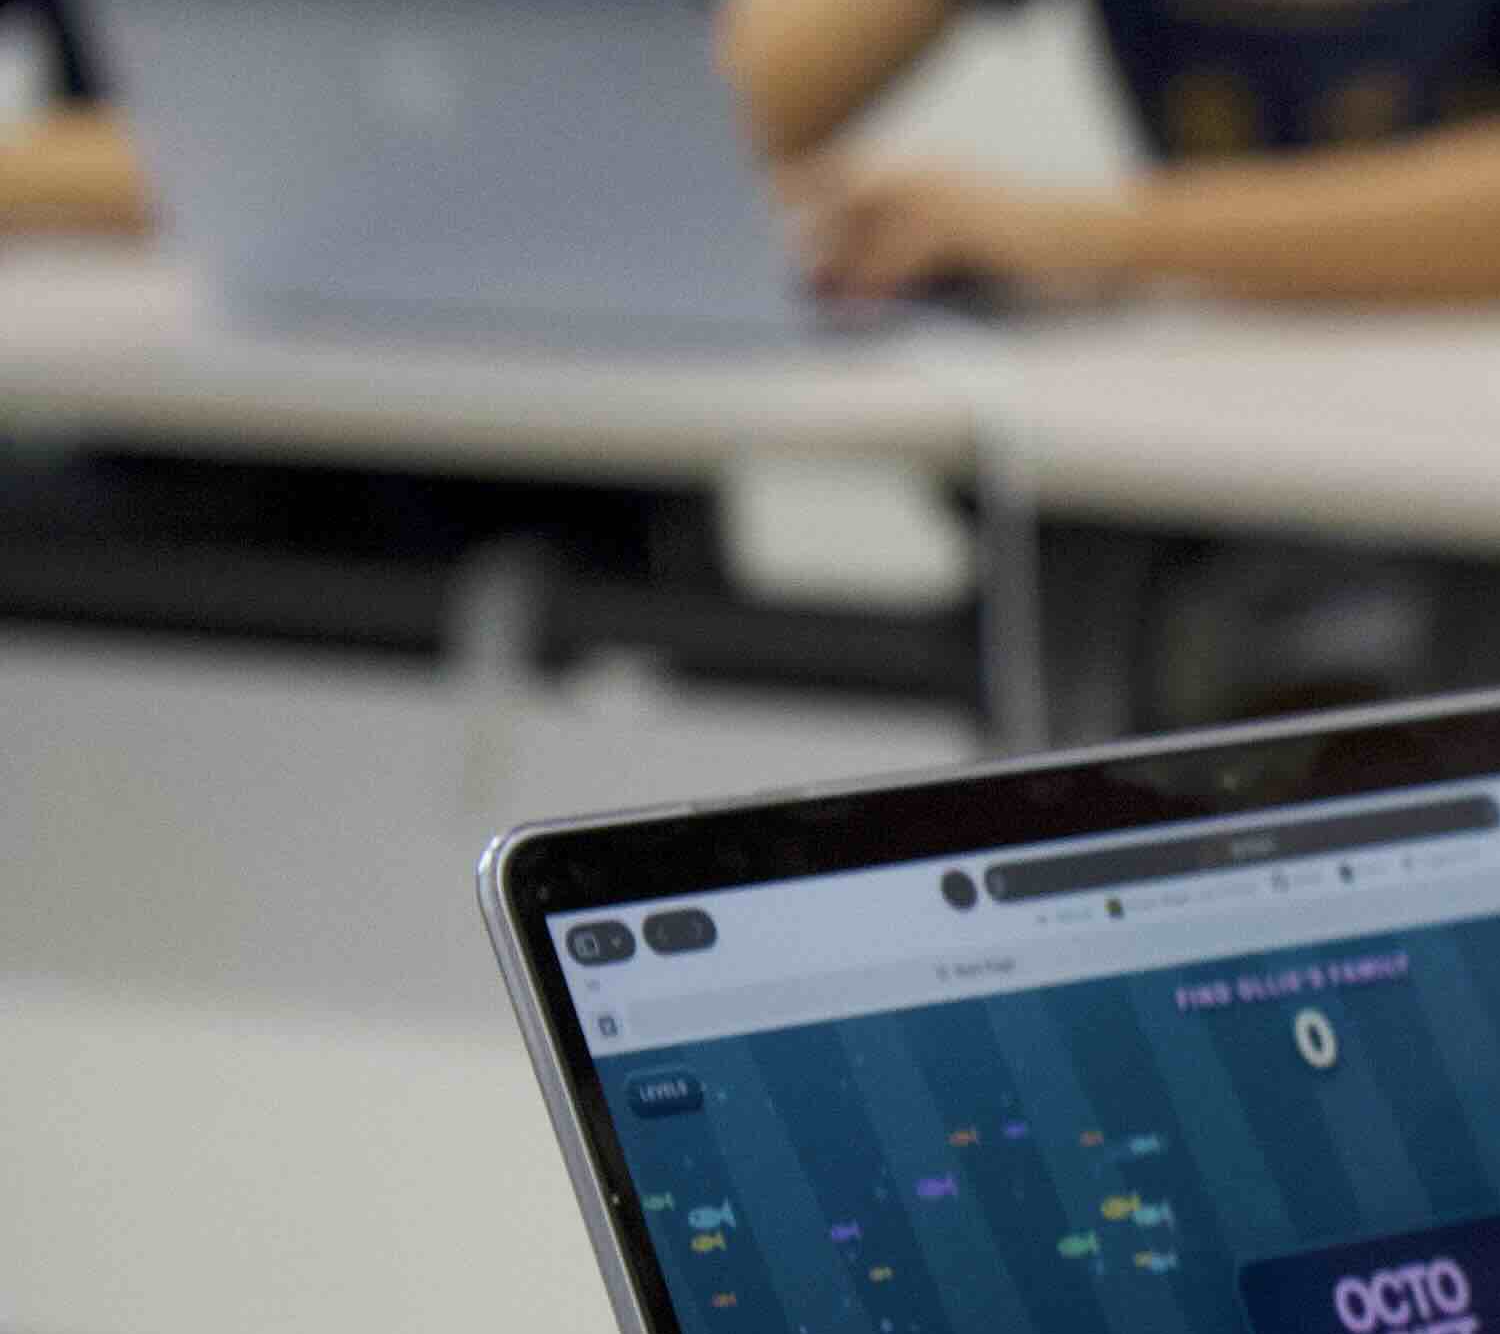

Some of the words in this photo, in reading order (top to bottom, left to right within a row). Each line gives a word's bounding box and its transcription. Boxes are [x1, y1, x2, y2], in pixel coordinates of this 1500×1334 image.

[1174, 980, 1233, 1011] FIND
[1327, 953, 1409, 987] FAMILY
[1294, 1007, 1337, 1068] 0
[1334, 1258, 1470, 1332] OCTO
